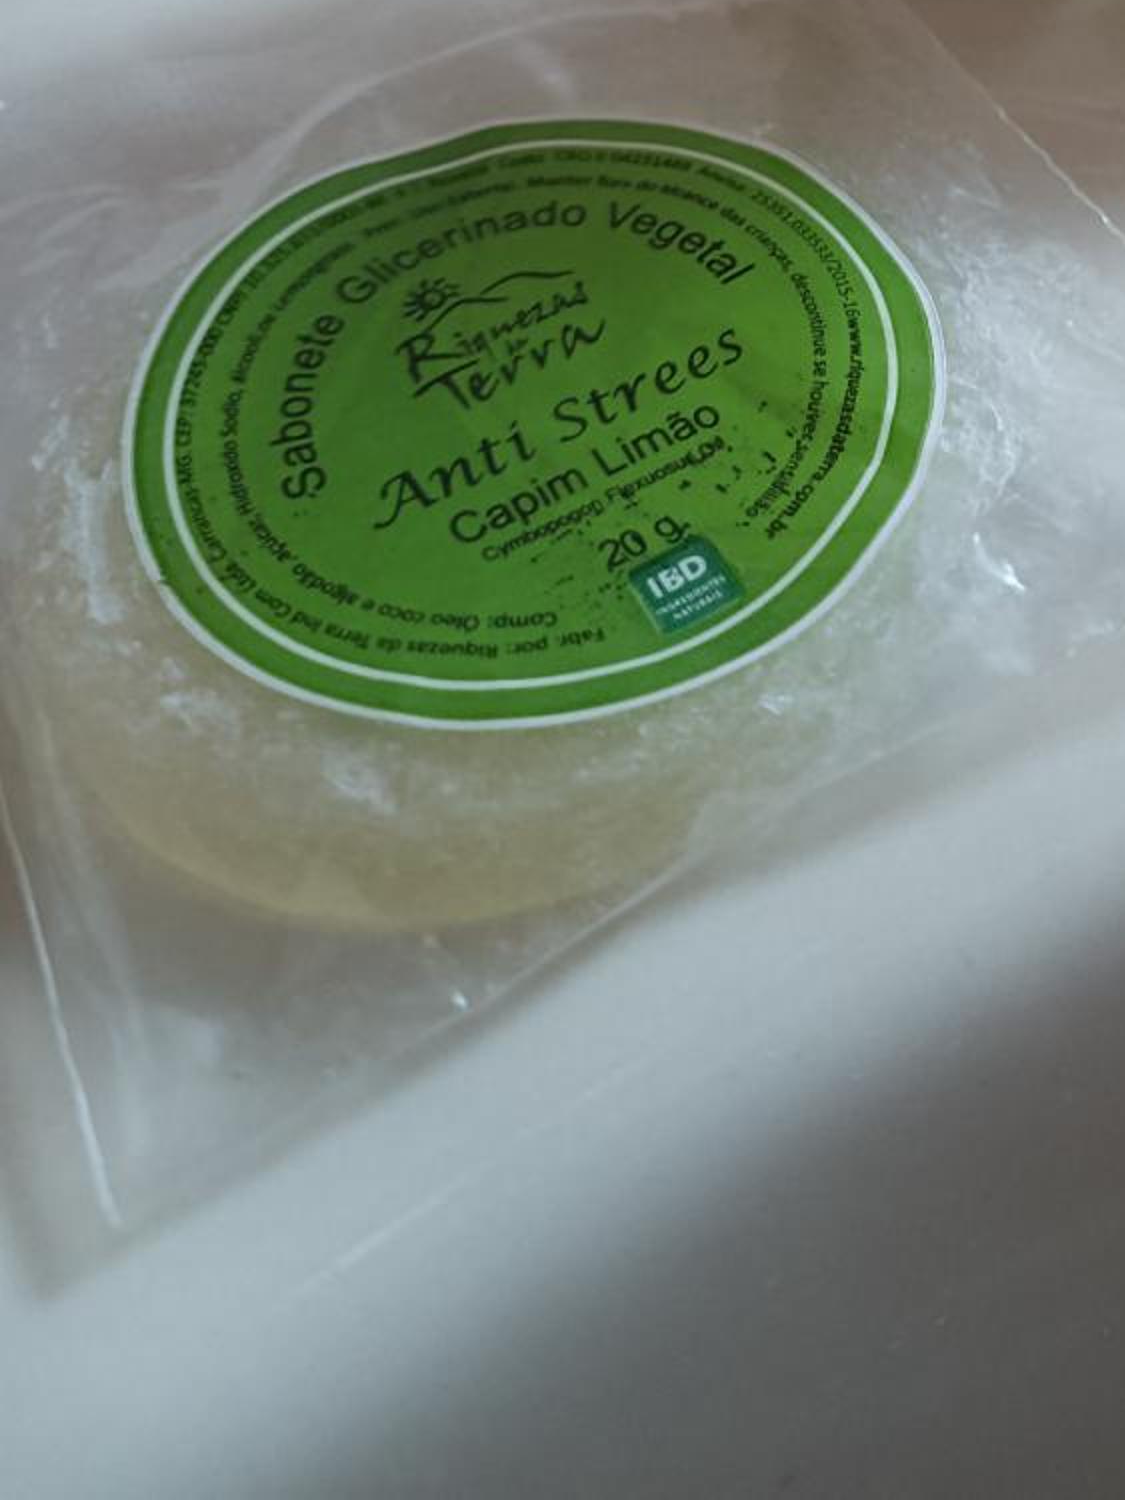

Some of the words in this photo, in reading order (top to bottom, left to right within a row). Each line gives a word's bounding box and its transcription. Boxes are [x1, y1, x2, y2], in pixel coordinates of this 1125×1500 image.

[269, 313, 345, 501] Sabonete
[336, 198, 587, 306] Glicerinado
[609, 200, 757, 285] Vegetal
[396, 282, 590, 385] Riquezas
[413, 320, 607, 410] Terra
[357, 598, 378, 613] e
[812, 356, 829, 378] se
[373, 419, 536, 530] Anti
[552, 328, 746, 444] Strees
[449, 467, 589, 544] Capim
[591, 405, 720, 477] Limão
[599, 529, 648, 572] 20
[645, 555, 708, 599] IBD
